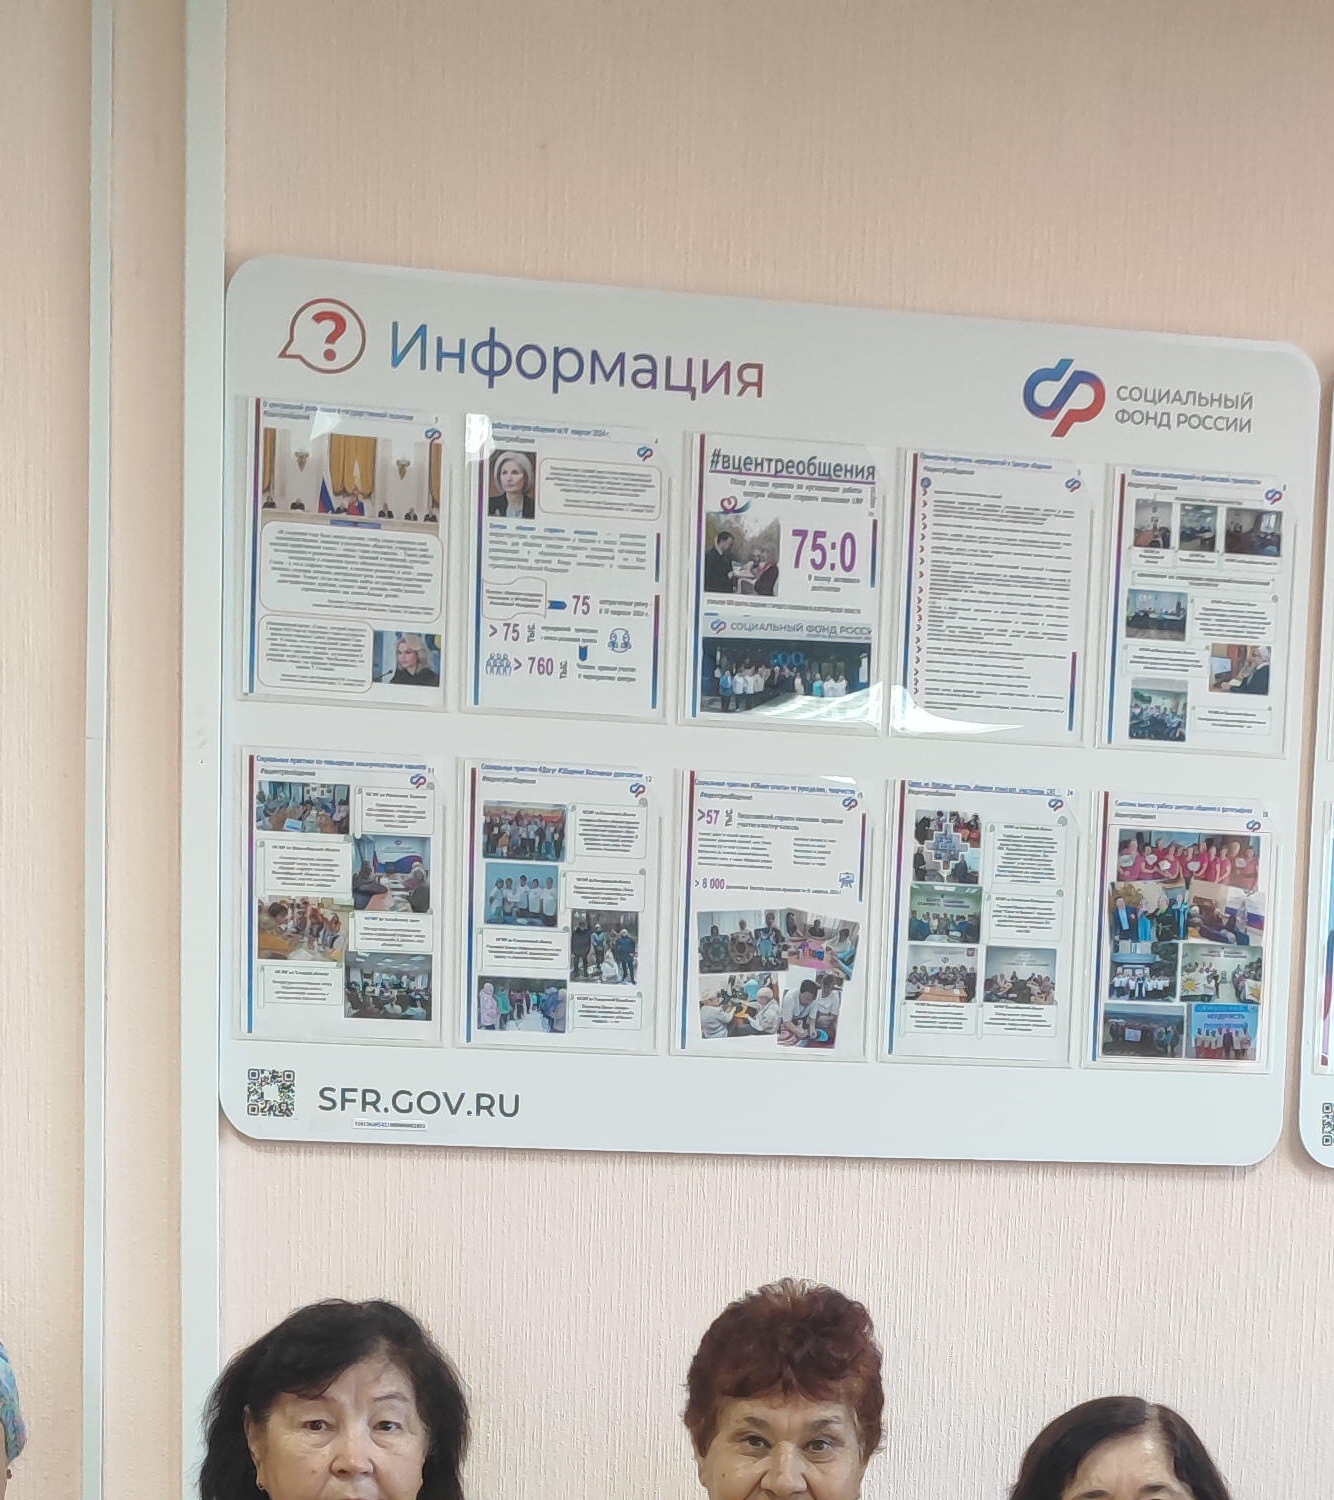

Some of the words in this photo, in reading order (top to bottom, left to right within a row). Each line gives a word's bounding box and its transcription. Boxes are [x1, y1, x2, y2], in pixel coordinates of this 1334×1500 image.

[390, 320, 766, 401] Информация
[1115, 384, 1254, 412] СОЦИАЛЬНЫЙ
[1114, 409, 1171, 432] ФОНД
[1176, 412, 1253, 434] РОССИИ
[710, 448, 876, 482] #вцентреобщения
[792, 529, 857, 572] 75:0
[572, 595, 591, 615] 75
[502, 623, 520, 642] 75
[528, 657, 554, 676] 760
[317, 1087, 520, 1118] SFR.GOV.RU
